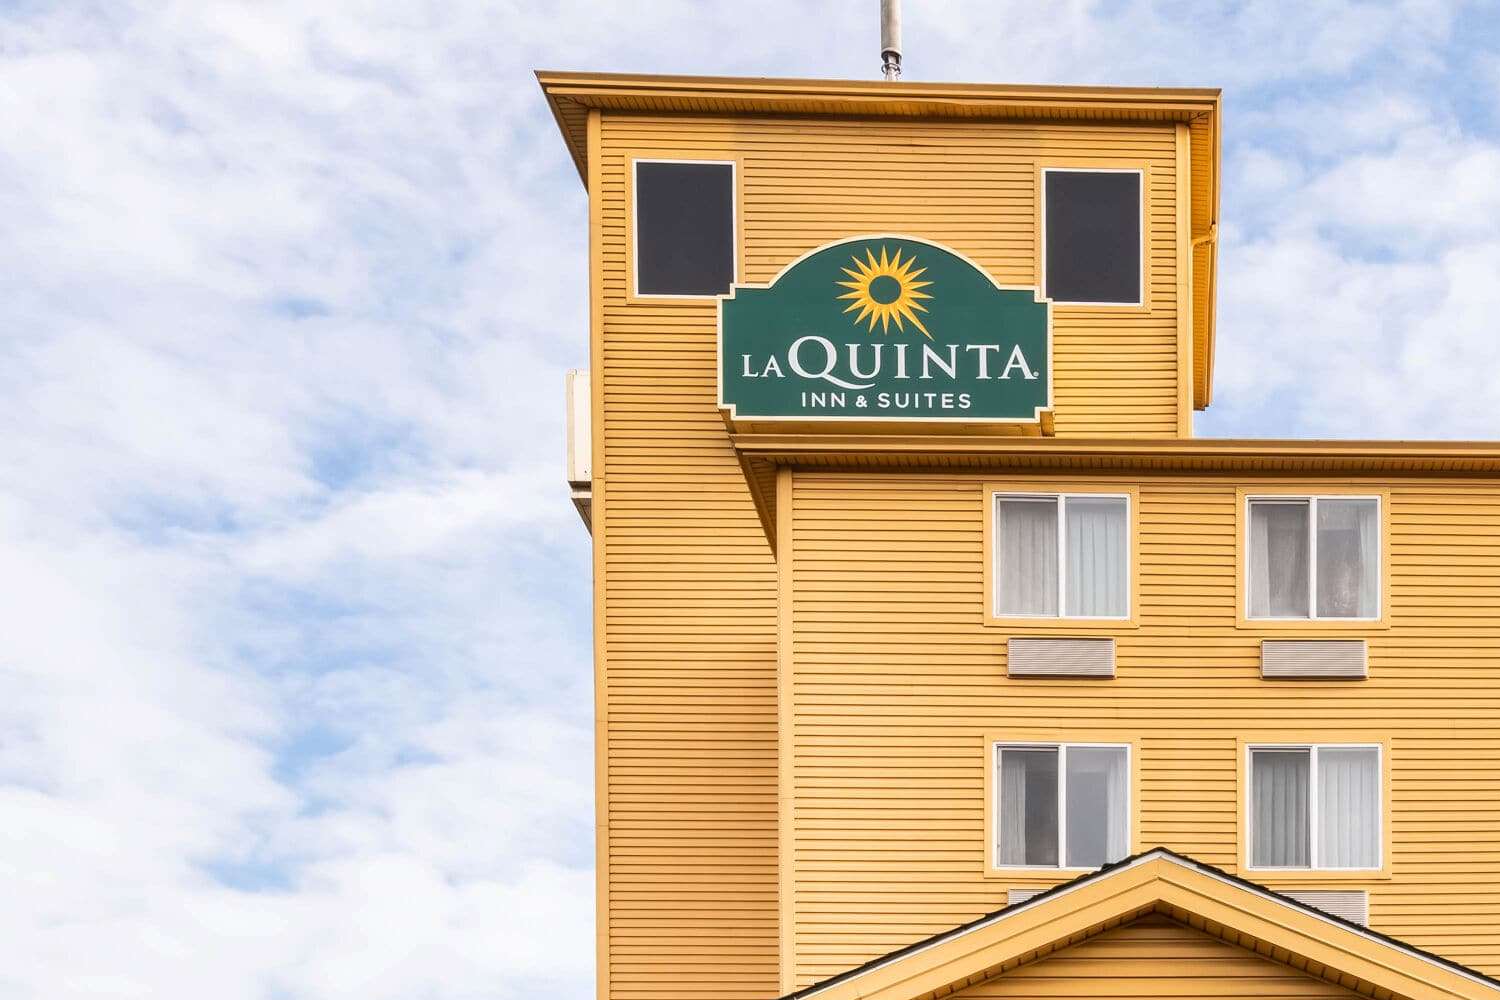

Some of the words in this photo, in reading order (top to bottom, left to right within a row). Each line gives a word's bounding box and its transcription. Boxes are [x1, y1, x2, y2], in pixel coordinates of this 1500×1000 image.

[741, 354, 786, 378] LA
[787, 335, 1036, 390] QUINTA
[801, 392, 846, 408] INN
[855, 394, 868, 409] &
[877, 392, 971, 409] SUITES
